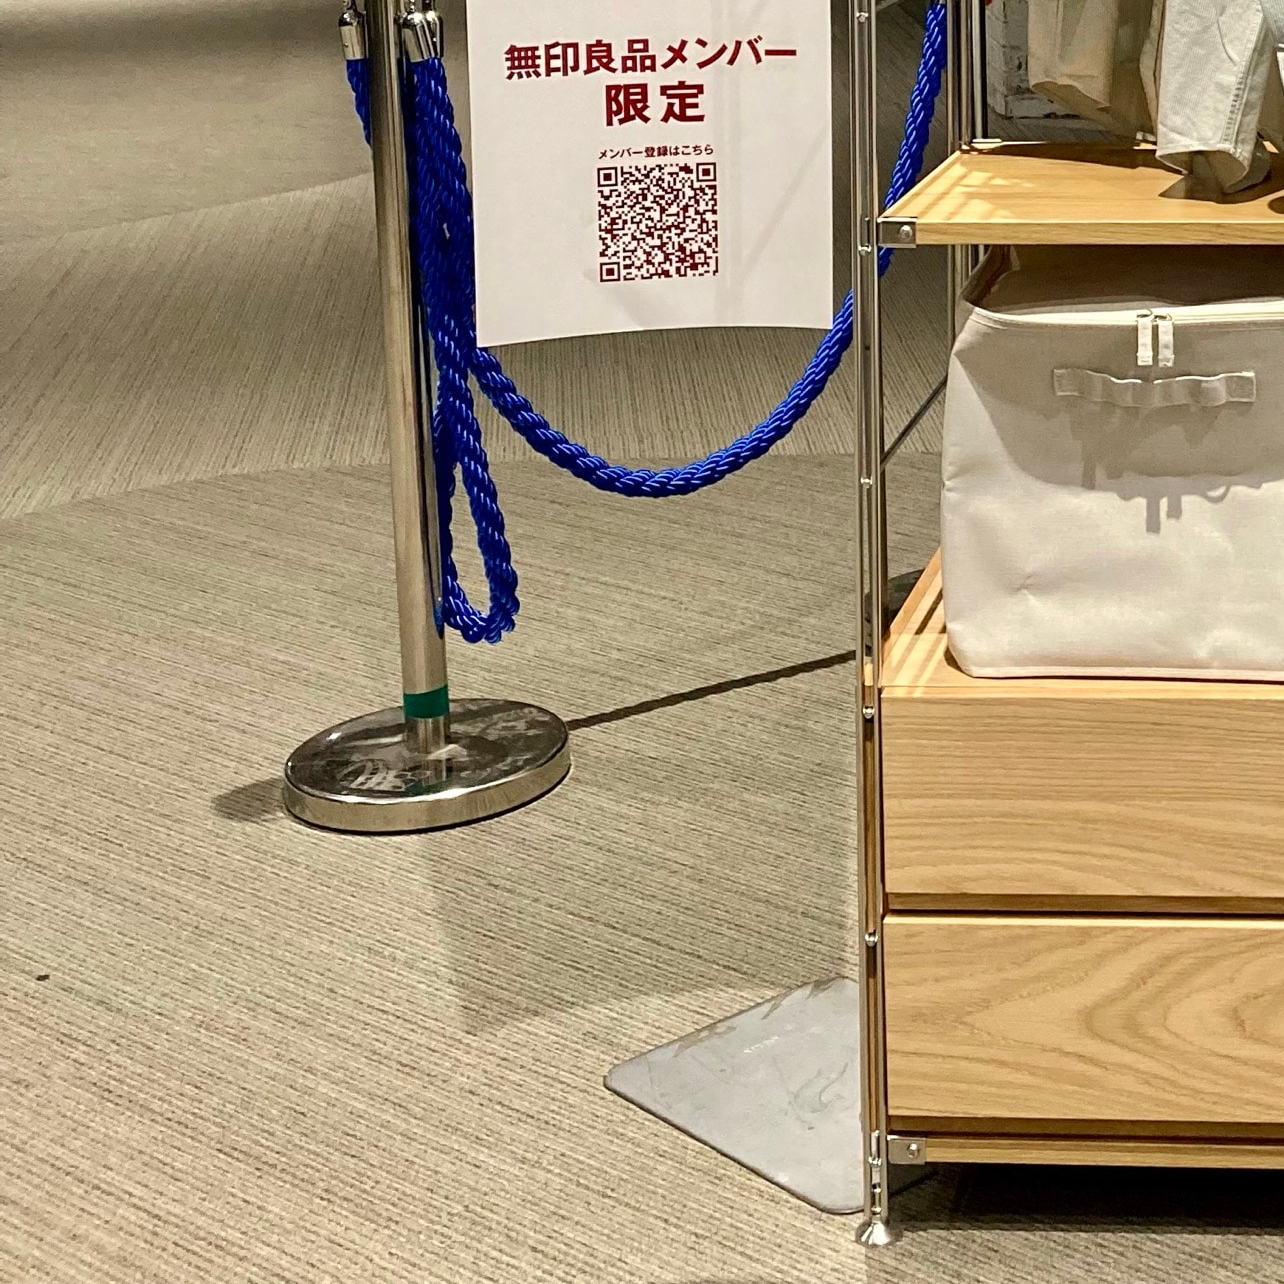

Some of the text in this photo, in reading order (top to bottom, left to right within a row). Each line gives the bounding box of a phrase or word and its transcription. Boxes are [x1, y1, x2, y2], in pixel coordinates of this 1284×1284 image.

[504, 35, 797, 80] 無印良品メンバー
[604, 81, 706, 126] 限定
[598, 144, 715, 160] メンバー登録はこちら
